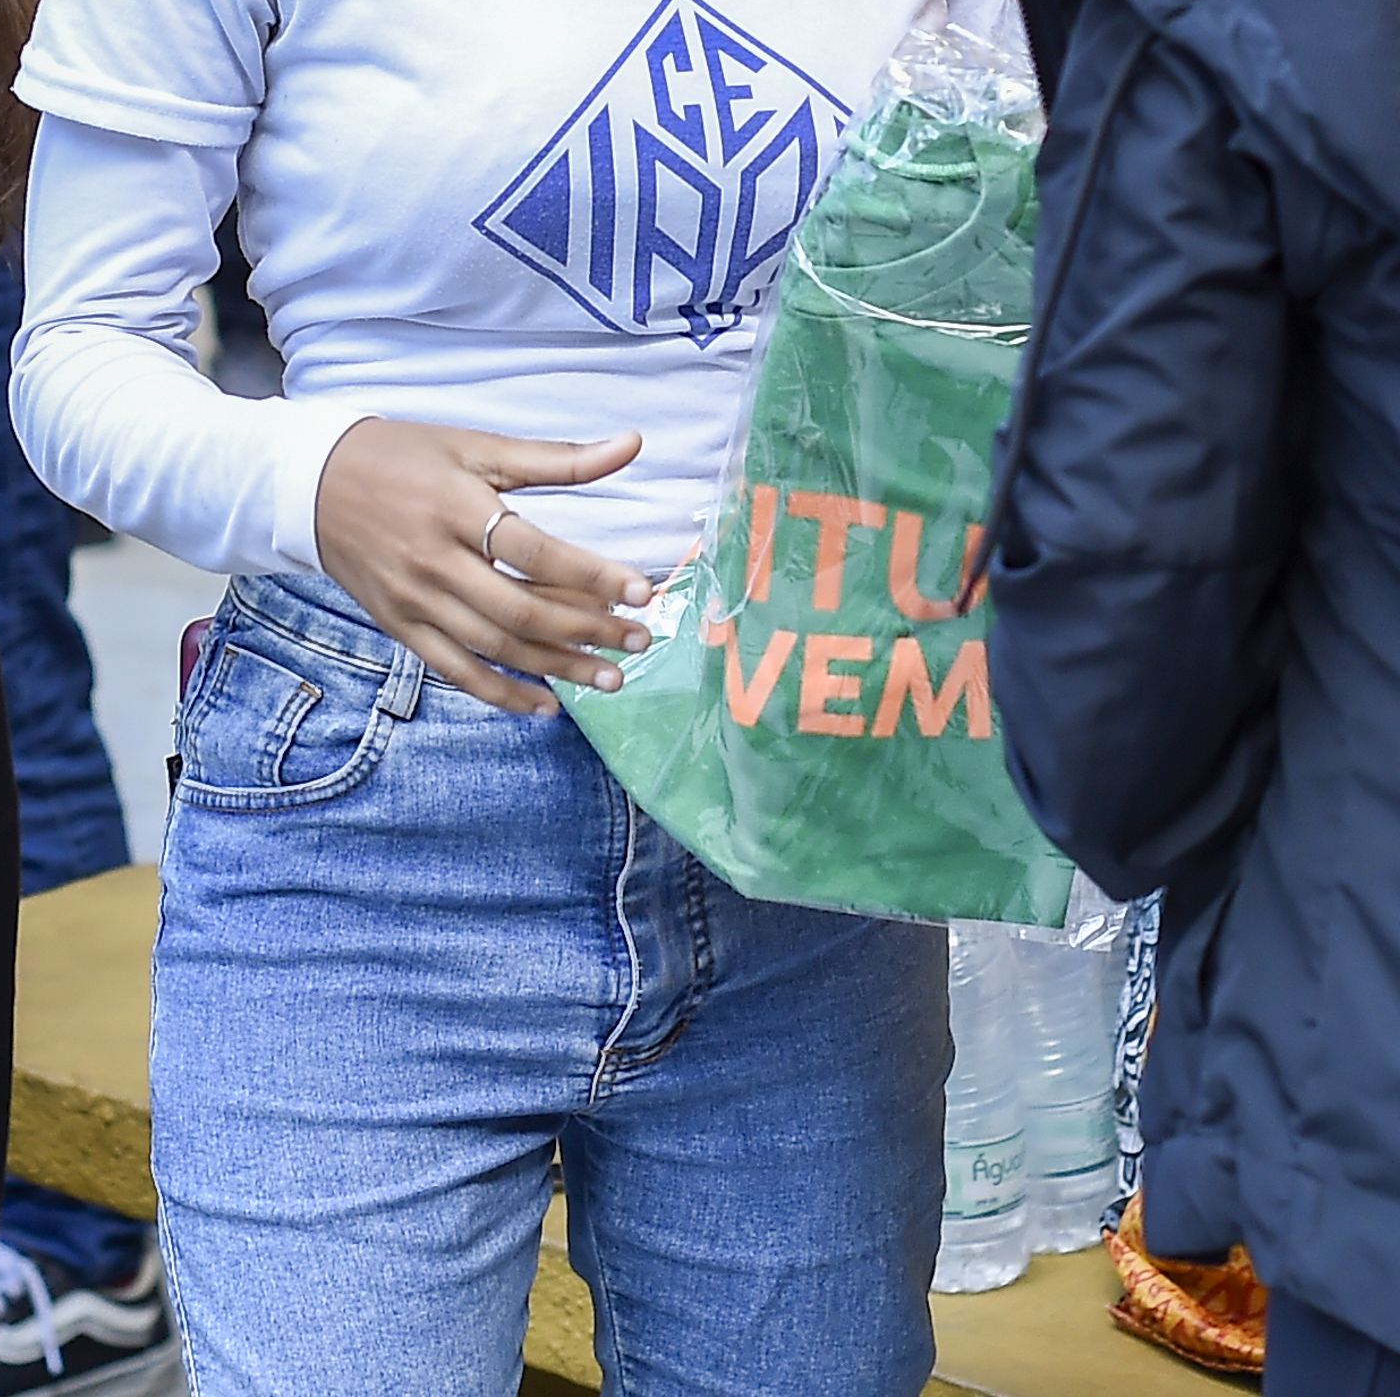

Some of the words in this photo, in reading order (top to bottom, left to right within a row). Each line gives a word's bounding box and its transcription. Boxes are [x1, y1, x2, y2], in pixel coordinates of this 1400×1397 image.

[646, 8, 778, 167] CE
[738, 478, 988, 622] ITU
[704, 612, 993, 740] VEM
